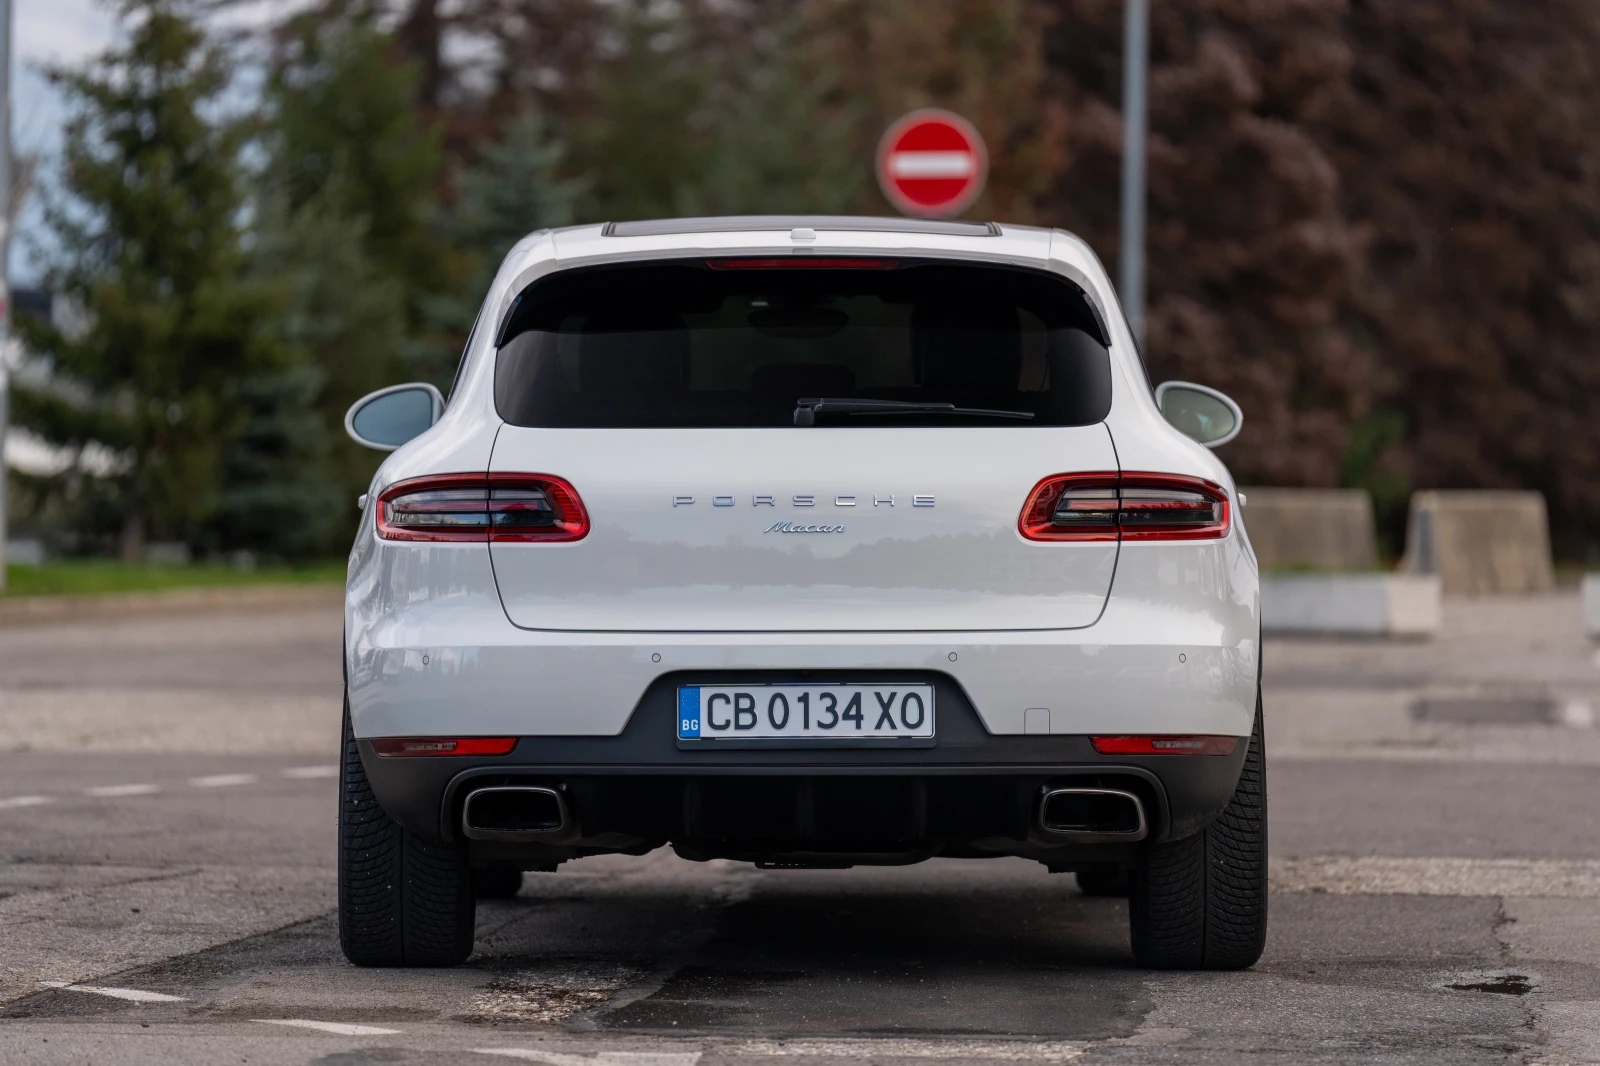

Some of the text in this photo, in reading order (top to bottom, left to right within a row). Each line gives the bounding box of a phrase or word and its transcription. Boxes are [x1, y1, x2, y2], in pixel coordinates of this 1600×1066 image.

[672, 494, 935, 507] PORSCHE
[763, 519, 845, 534] Macan
[707, 691, 925, 730] CB 0134 XO
[682, 719, 699, 731] BG
